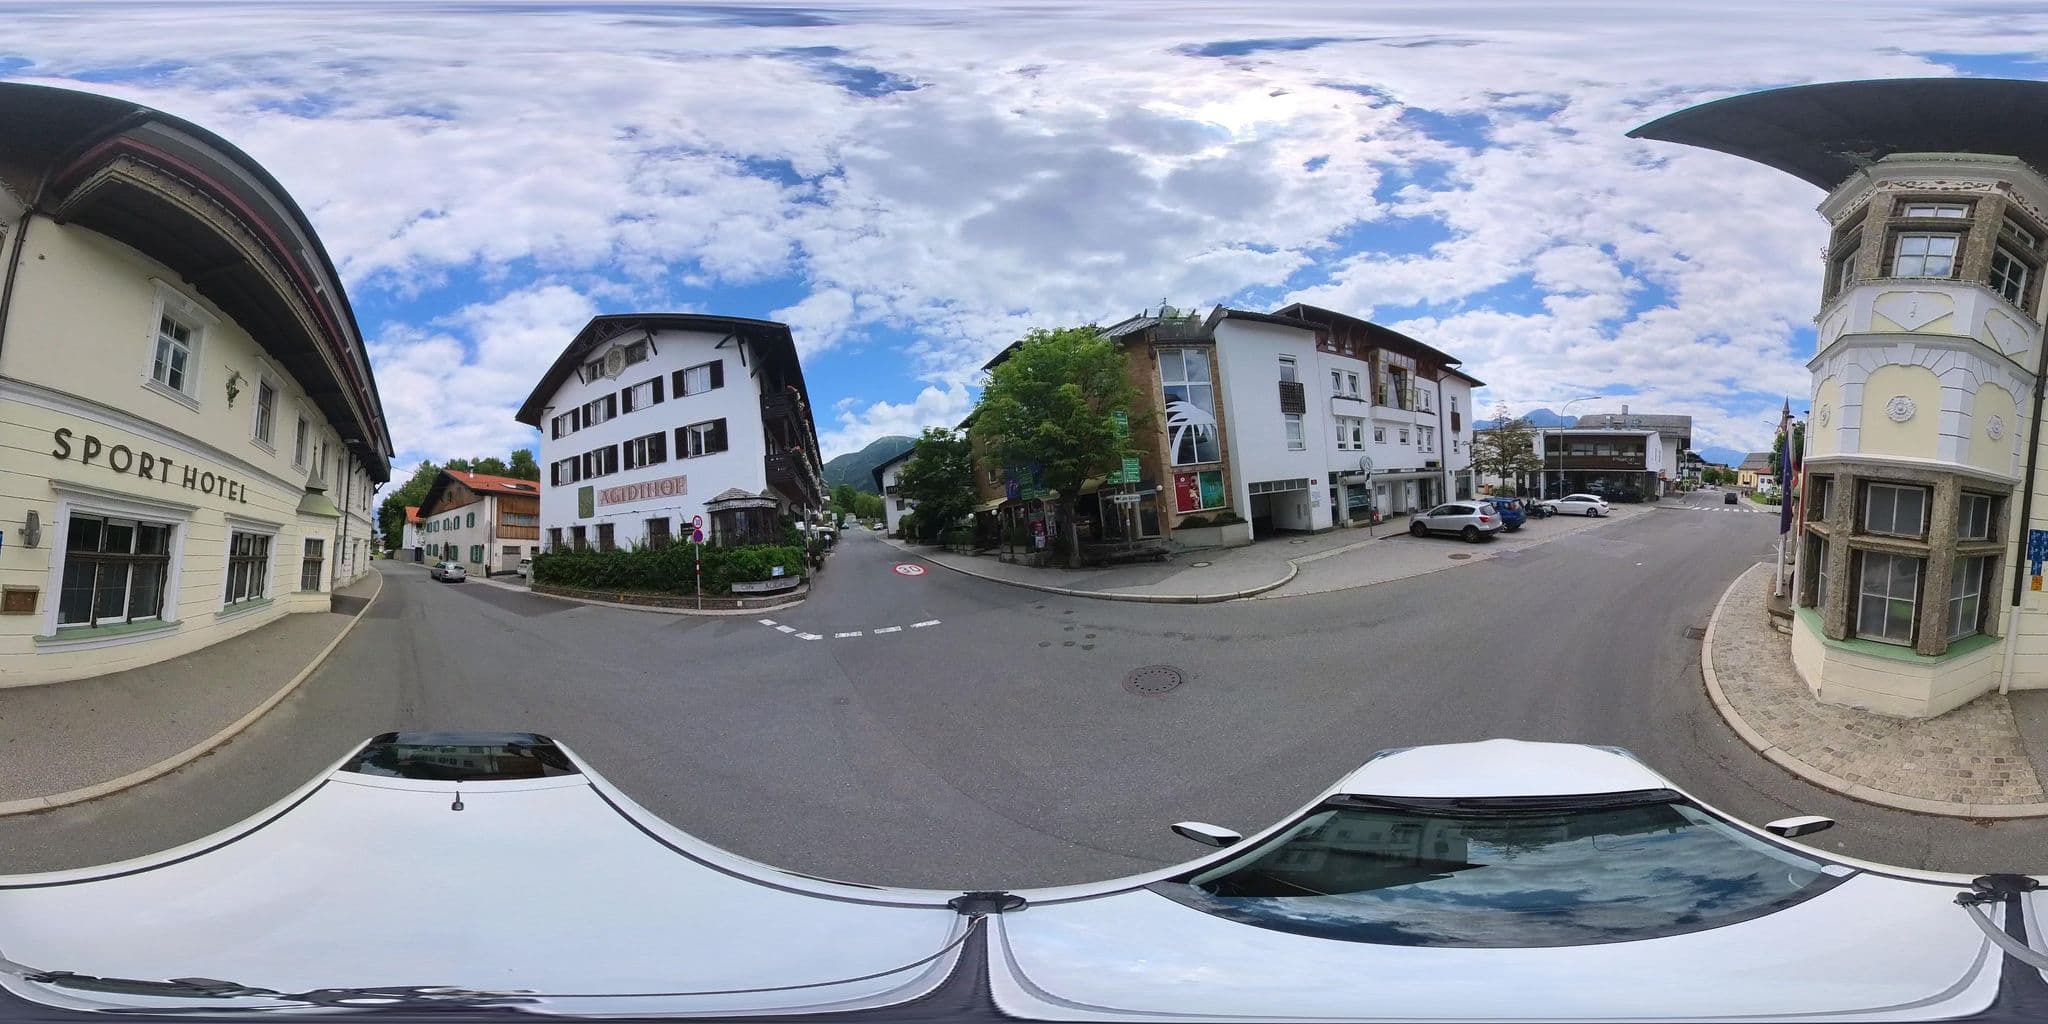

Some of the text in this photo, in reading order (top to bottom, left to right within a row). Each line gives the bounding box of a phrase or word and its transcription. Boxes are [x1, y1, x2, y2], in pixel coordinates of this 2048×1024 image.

[52, 427, 247, 504] SPORT HOTEL
[898, 565, 921, 574] 30
